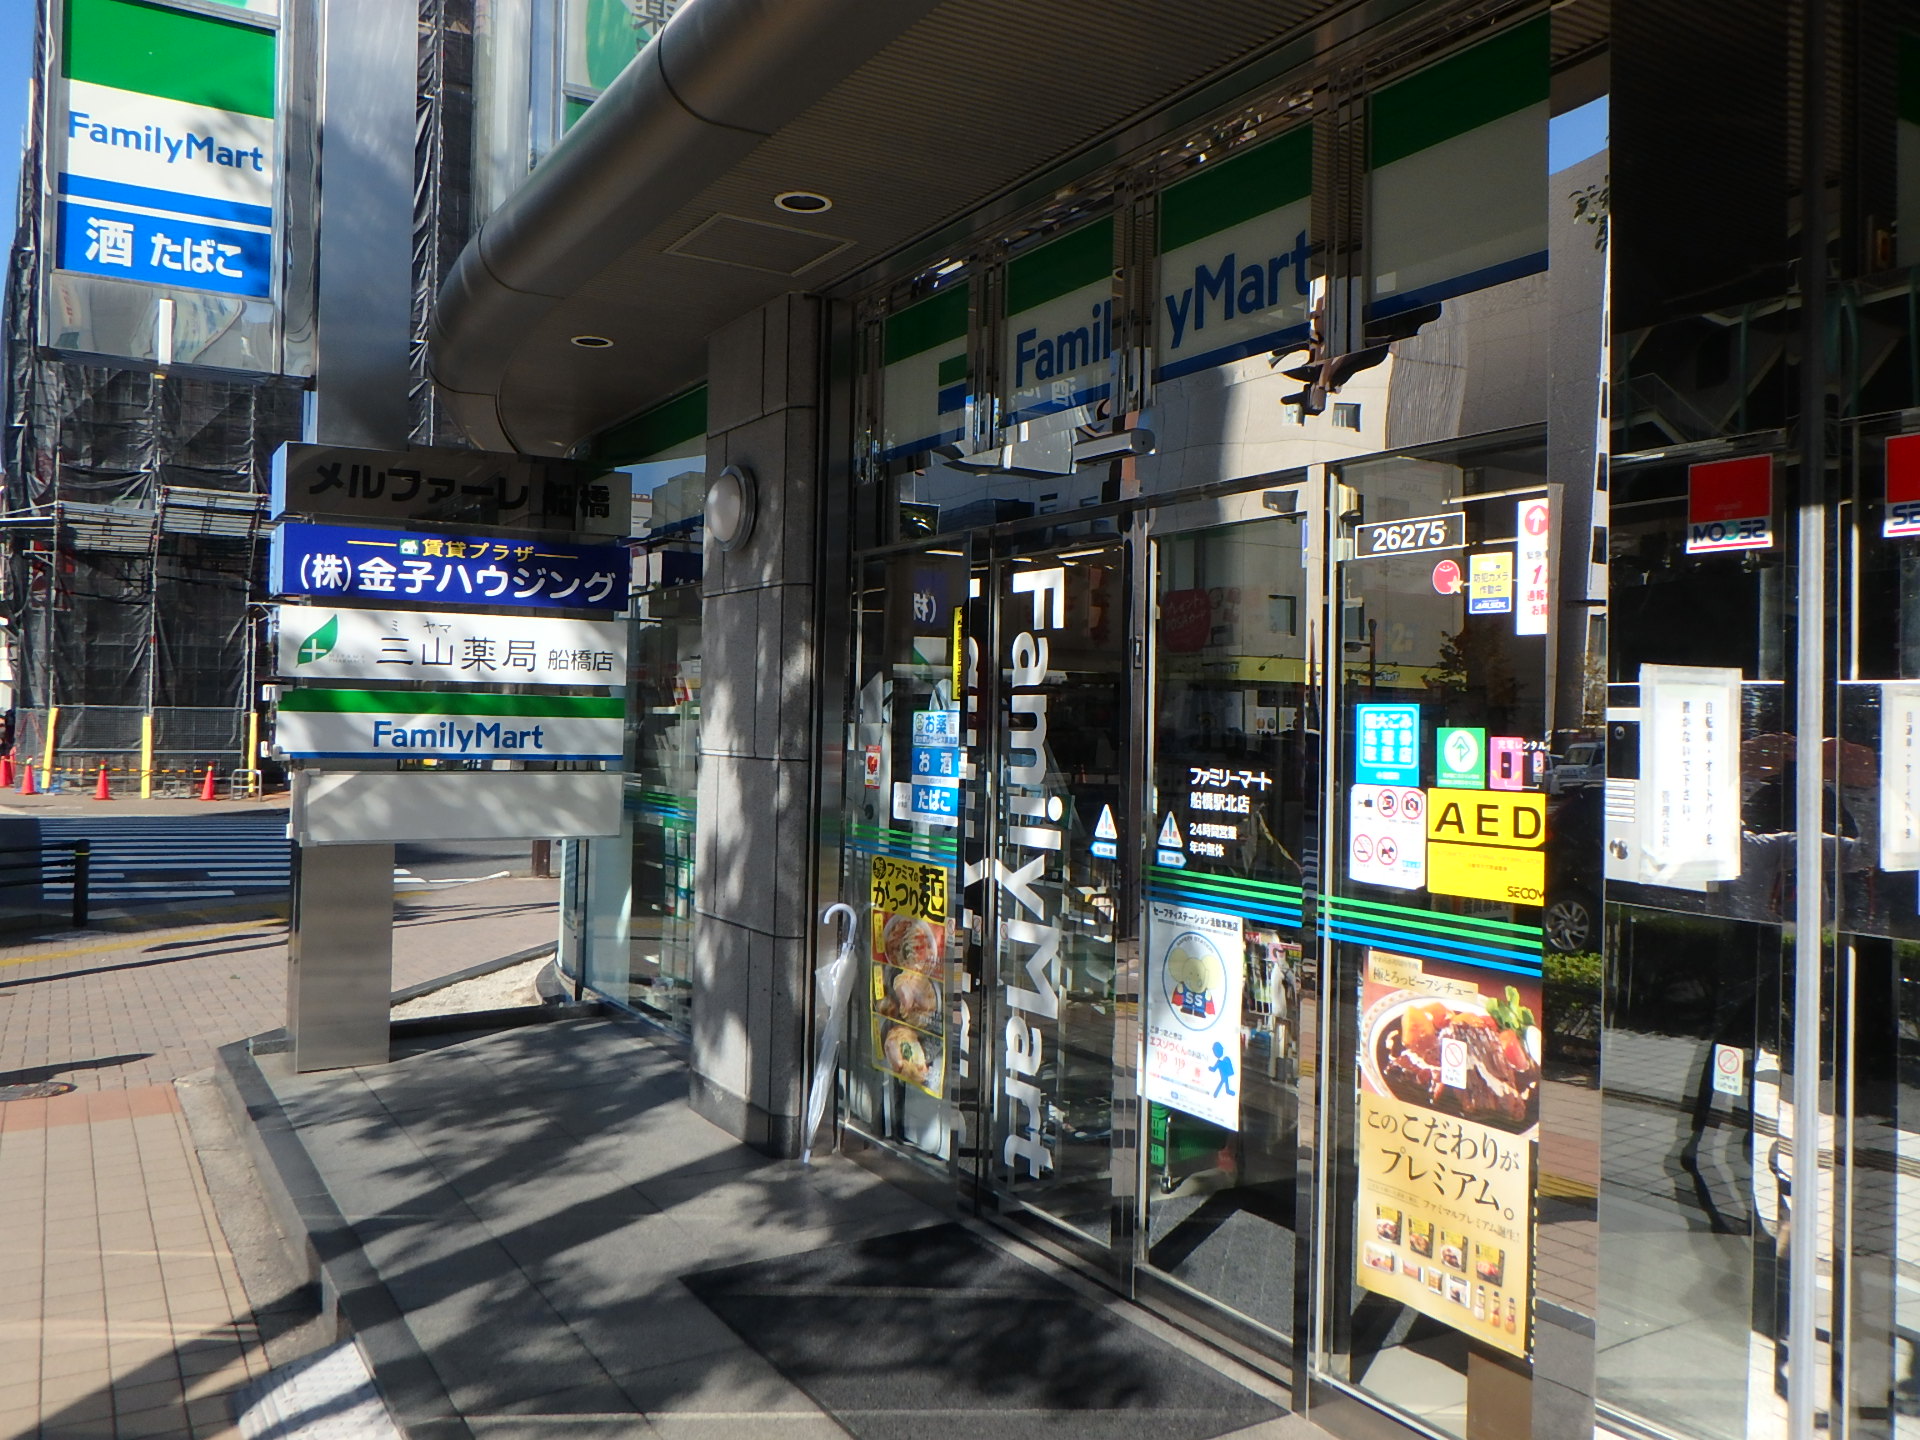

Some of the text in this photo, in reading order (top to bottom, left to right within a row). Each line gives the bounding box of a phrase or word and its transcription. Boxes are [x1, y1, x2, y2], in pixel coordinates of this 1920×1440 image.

[68, 109, 264, 172] FamilyMart
[84, 216, 244, 279] 酒 たばこ
[421, 538, 535, 563] 賃貸プラザ
[1373, 521, 1445, 552] 26275
[300, 552, 616, 603] (株)金子ハウジング
[375, 636, 615, 673] 三山薬局 船橋店
[373, 720, 544, 753] FamilyMart
[925, 714, 947, 735] お薬
[1190, 768, 1273, 791] ファミリーマート
[917, 788, 951, 812] たばこ
[1190, 792, 1250, 814] 船橋駅北店
[1189, 822, 1238, 840] 24時間営業
[1434, 802, 1541, 839] AED
[1189, 841, 1225, 857] 年中無休
[887, 862, 919, 882] ファミマの
[994, 567, 1065, 1180] FamilyMart
[873, 880, 919, 916] がっつり
[1367, 1108, 1520, 1172] このこだわりが
[1381, 1147, 1515, 1221] プレミアム。
